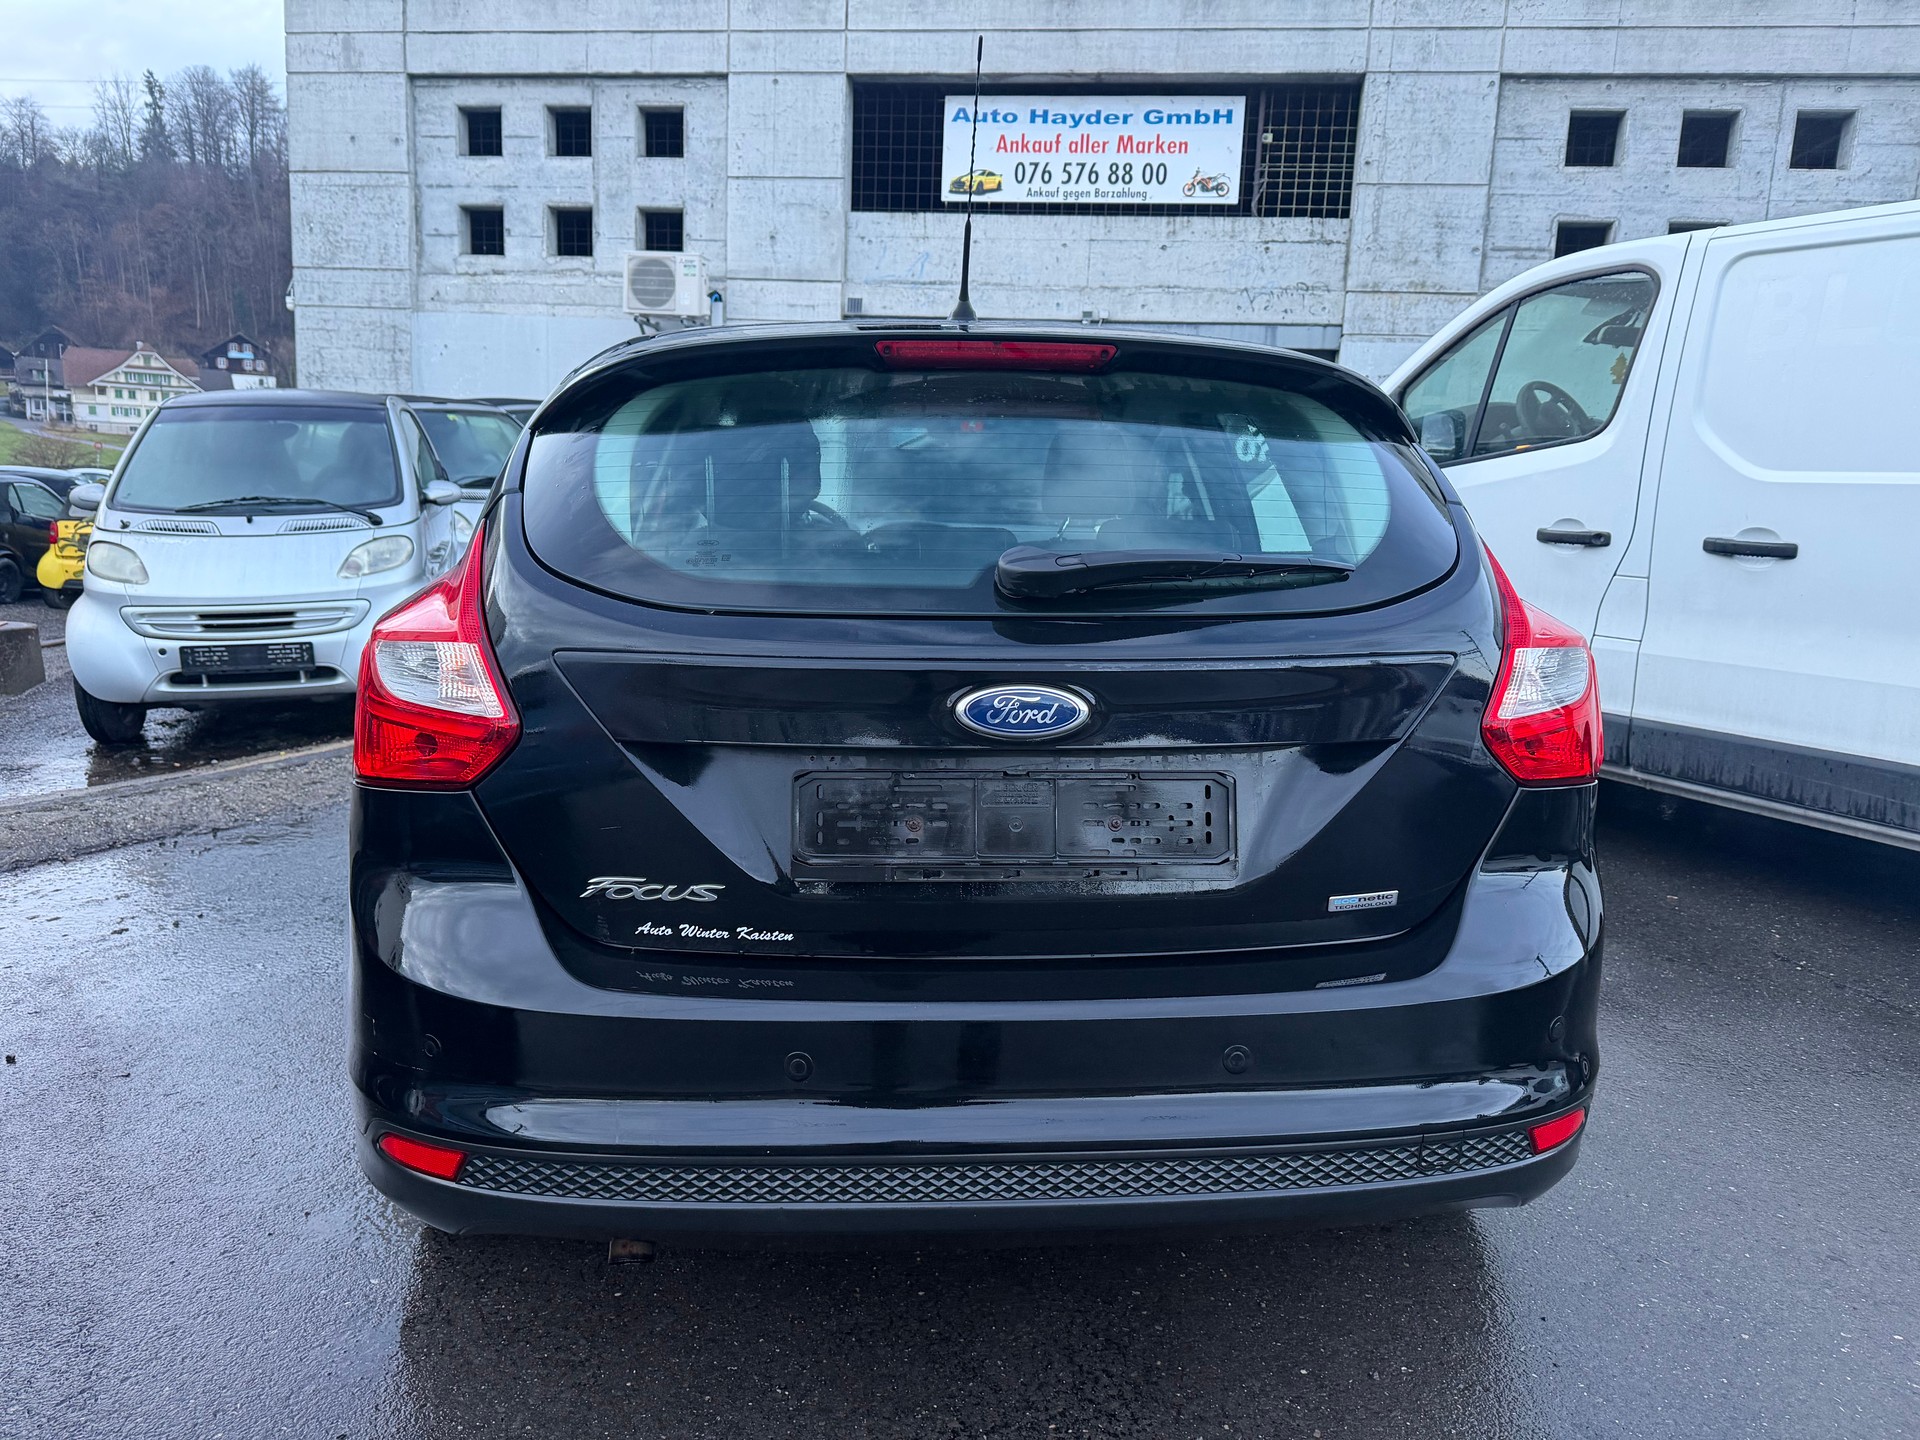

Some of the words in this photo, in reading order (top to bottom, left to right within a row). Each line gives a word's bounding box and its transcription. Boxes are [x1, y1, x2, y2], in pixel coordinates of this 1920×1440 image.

[951, 107, 1018, 123] Auto
[1029, 108, 1134, 128] Hayder
[1143, 108, 1233, 125] GmbH
[996, 134, 1062, 154] Ankauf
[1068, 134, 1109, 154] aller
[1116, 134, 1189, 154] Marken
[1014, 162, 1052, 184] 076
[1061, 162, 1099, 184] 576
[1108, 163, 1134, 185] 88
[1142, 163, 1168, 185] 00
[1026, 187, 1060, 198] Ankauf
[1062, 189, 1091, 200] gegen
[1094, 188, 1148, 200] Barzahlung
[986, 695, 1058, 724] Ford
[1334, 900, 1393, 910] TECHNOLOGY
[635, 922, 673, 935] Auto
[678, 923, 730, 939] Winter
[736, 927, 794, 941] Kaisten
